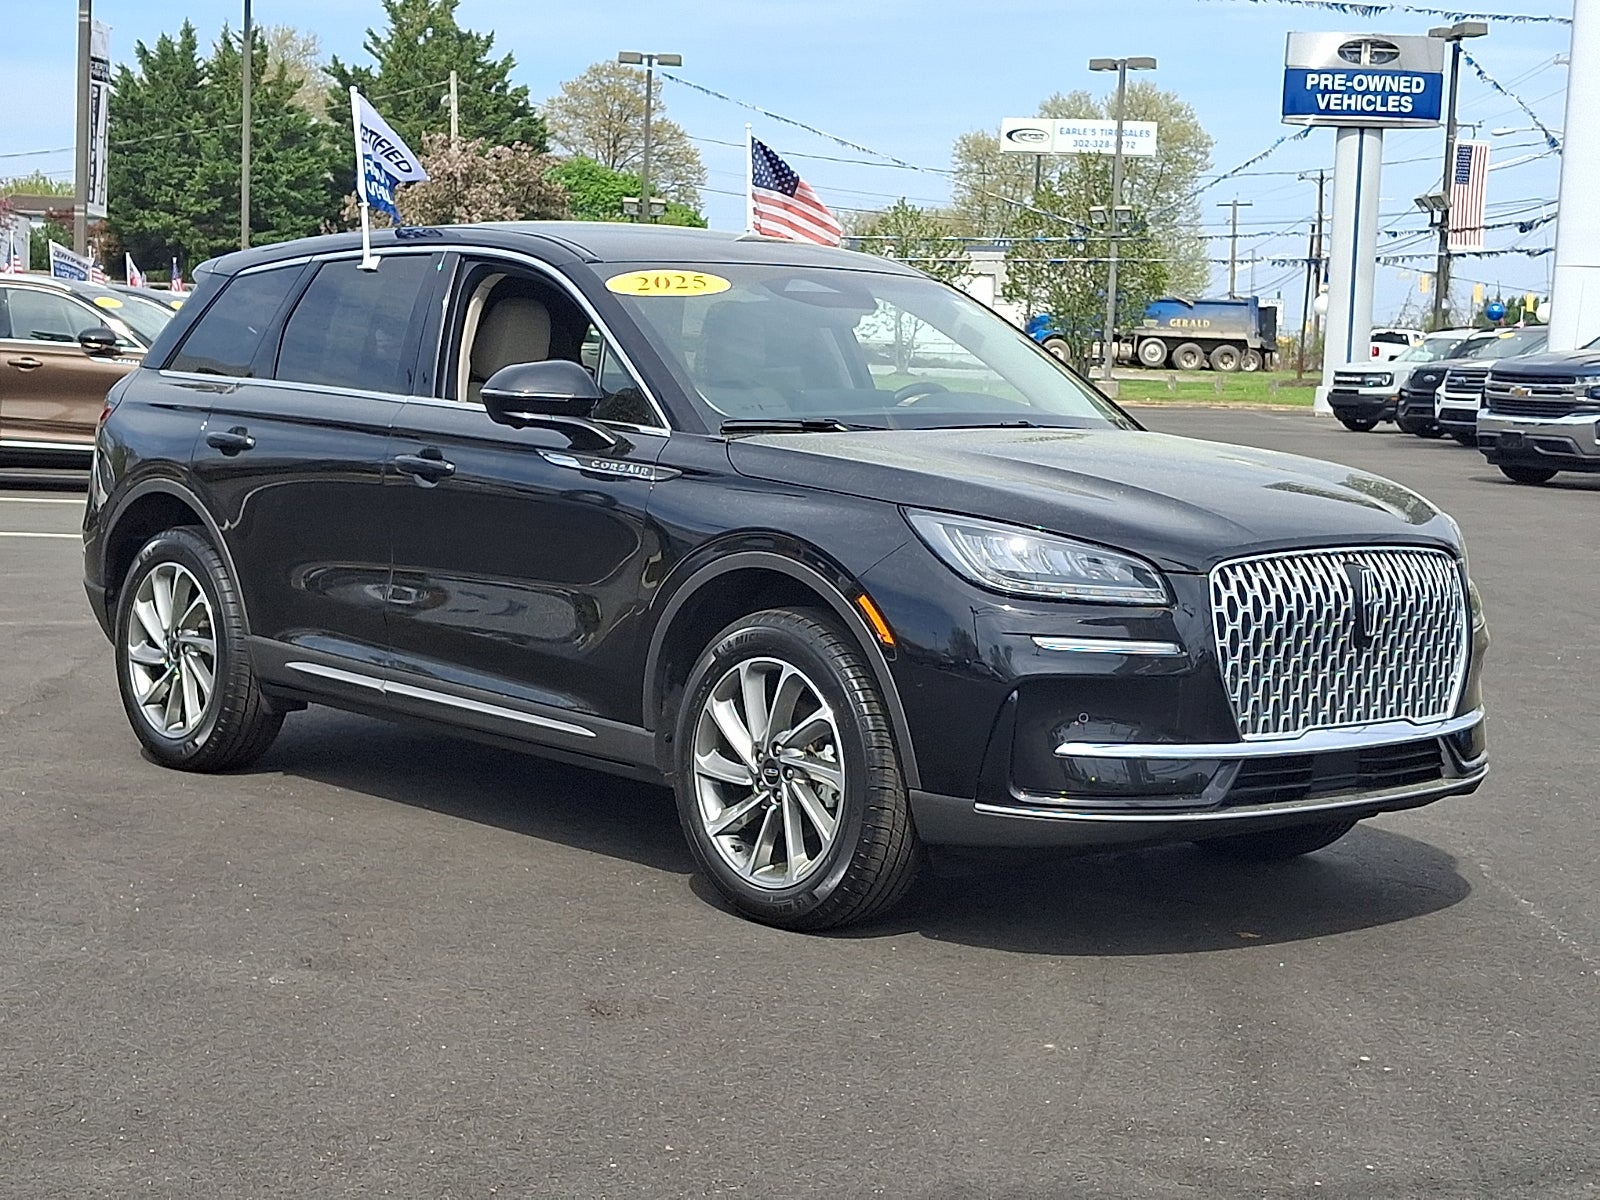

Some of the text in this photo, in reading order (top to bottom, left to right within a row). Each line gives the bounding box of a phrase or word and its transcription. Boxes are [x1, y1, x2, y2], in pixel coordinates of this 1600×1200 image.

[1306, 73, 1425, 94] PRE-OWNED
[1316, 94, 1413, 113] VEHICLES
[1059, 127, 1097, 136] EARLE'S
[1122, 129, 1150, 138] SALES
[1072, 139, 1136, 149] 302-328-72
[635, 275, 707, 291] 2025
[591, 460, 649, 476] CORSAIR
